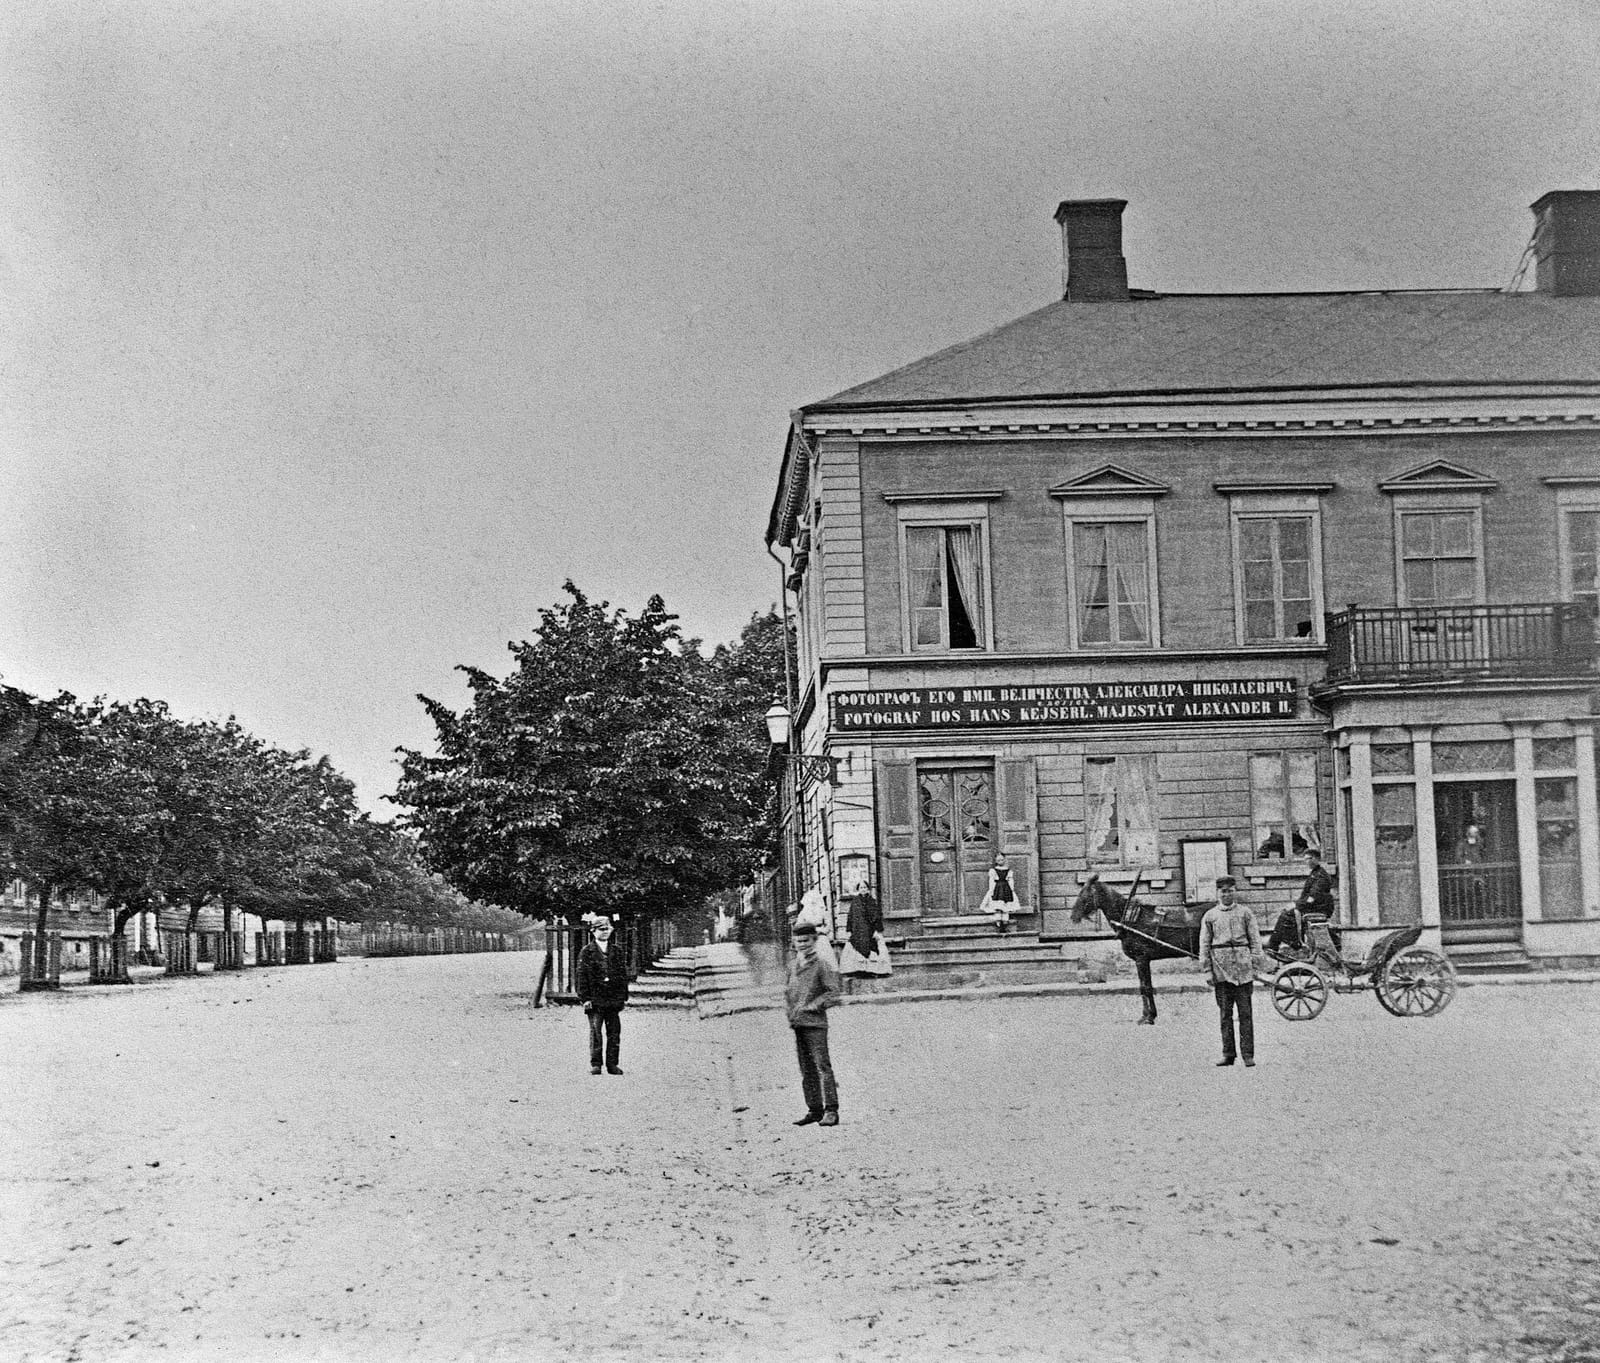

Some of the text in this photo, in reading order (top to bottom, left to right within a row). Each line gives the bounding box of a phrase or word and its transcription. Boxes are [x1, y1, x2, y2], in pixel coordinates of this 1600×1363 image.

[838, 691, 921, 706] ФОТОГРАФЪ
[929, 690, 956, 704] ЕГО
[1000, 686, 1091, 702] ВЕЛИЧЕСТВА
[844, 710, 921, 725] FOTOGRAF
[931, 710, 961, 723] HOS
[970, 708, 1011, 722] HANS
[1020, 705, 1094, 721] KEJSERL.
[1183, 702, 1272, 717] ALEXANDER
